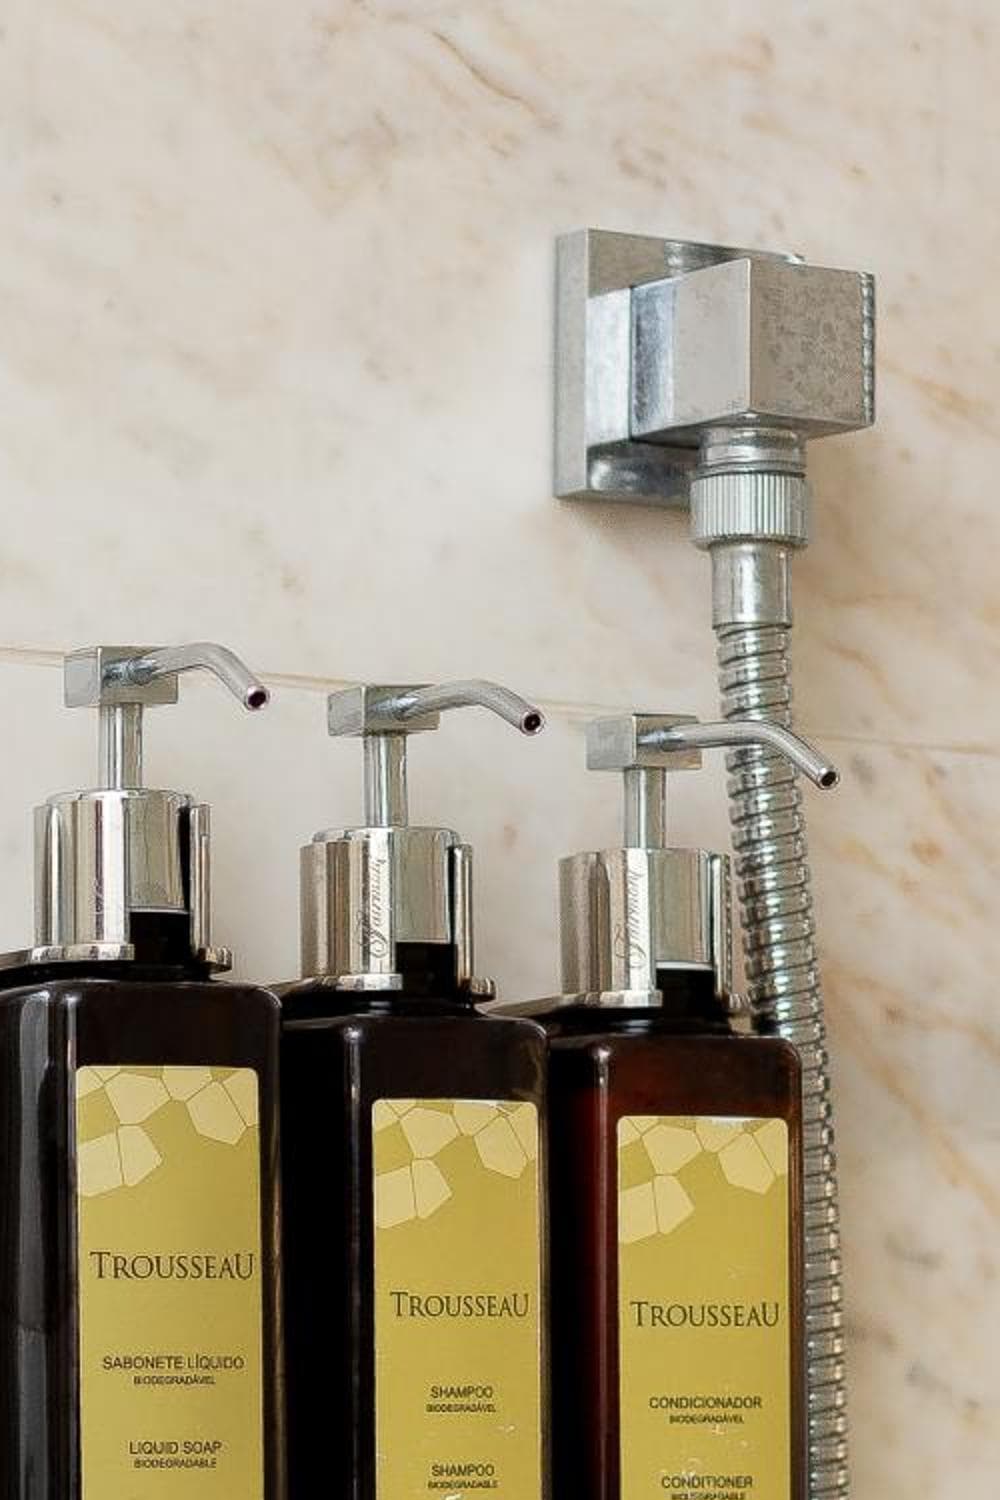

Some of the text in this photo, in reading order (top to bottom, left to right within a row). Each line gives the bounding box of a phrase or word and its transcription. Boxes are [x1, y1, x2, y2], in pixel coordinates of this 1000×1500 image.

[89, 1250, 255, 1281] TROUSSEAU
[390, 1291, 529, 1318] TROUSSEAU
[630, 1301, 780, 1327] TROUSSEAU
[103, 1353, 245, 1370] SABONETE LÍQUIDO
[133, 1374, 216, 1385] BIODEGRADÁVEL
[430, 1385, 493, 1399] SHAMPOO
[649, 1397, 762, 1409] CONDICIONADOR
[128, 1441, 222, 1455] LIQUID SOAP
[133, 1457, 217, 1469] BIODEGRADABLE
[431, 1464, 495, 1477] SHAMPOO
[661, 1475, 753, 1489] CONDITIONER
